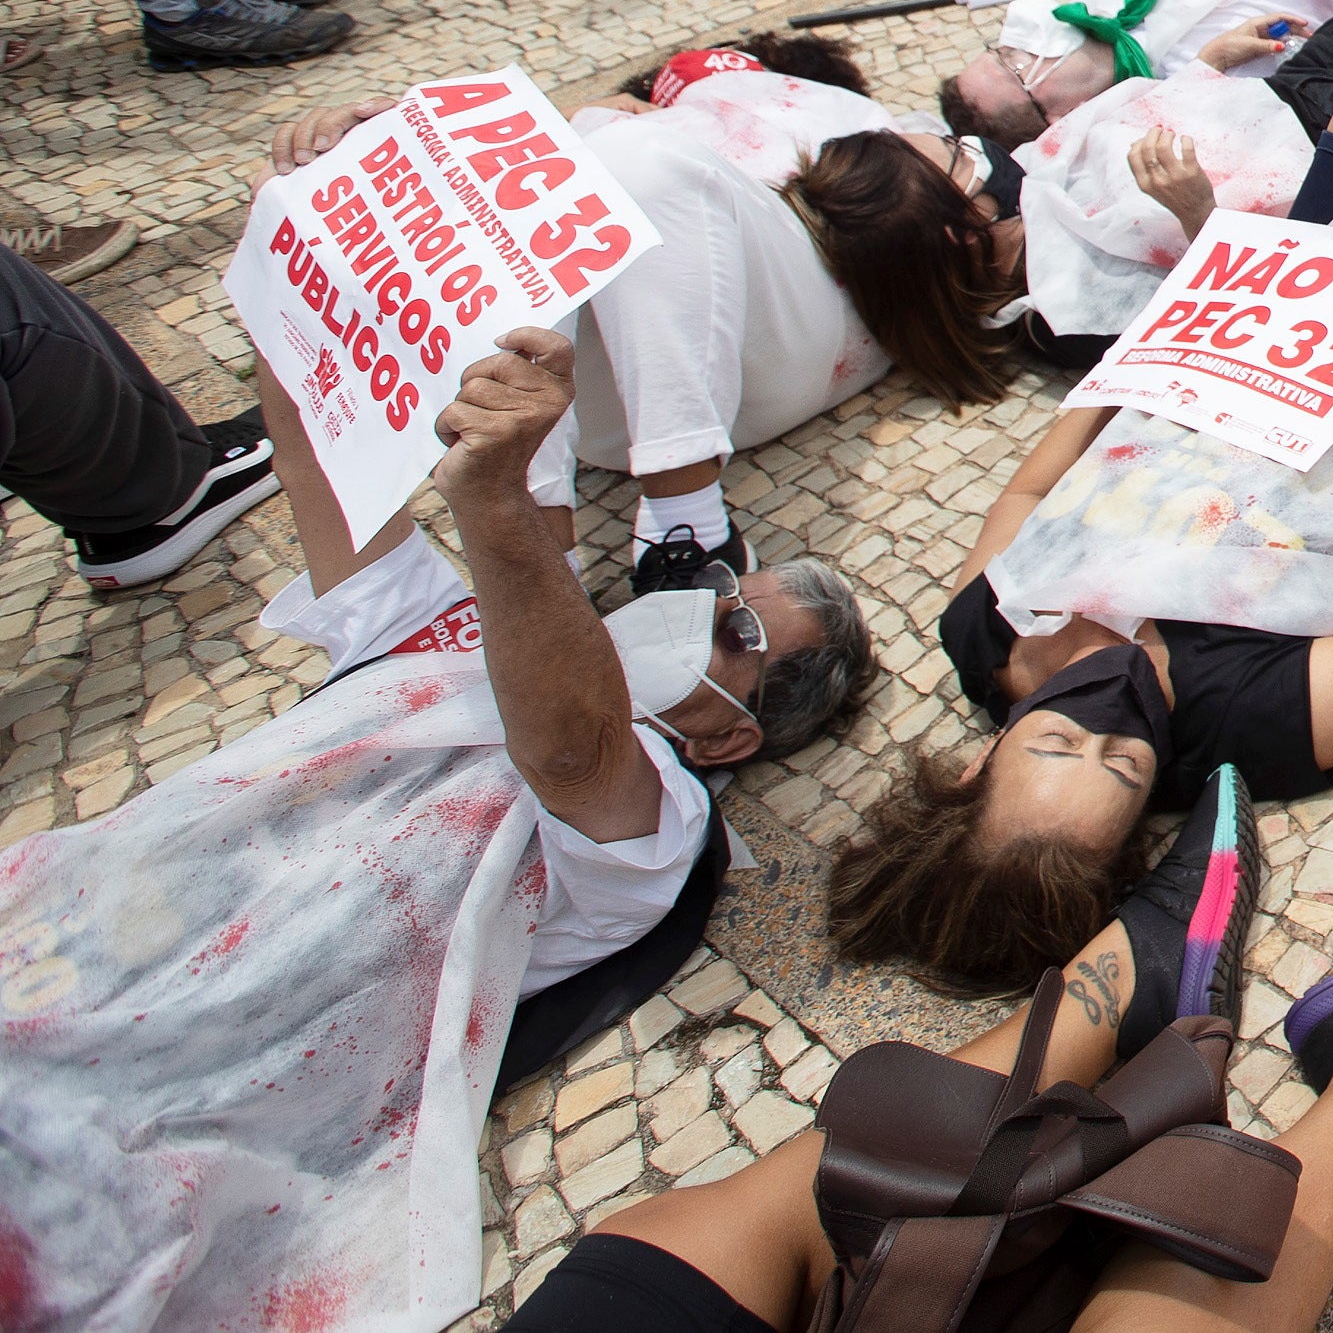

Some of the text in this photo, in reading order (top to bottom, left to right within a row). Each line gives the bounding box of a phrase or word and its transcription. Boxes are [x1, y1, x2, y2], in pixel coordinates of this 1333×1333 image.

[358, 136, 498, 327] DESTRÓI OS
[421, 82, 632, 298] A PEC 32
[443, 164, 556, 309] ADMINISTRATIVA)
[269, 215, 420, 432] PÚBLICOS
[311, 175, 452, 375] SERVIÇOS
[1138, 300, 1271, 350] PEC
[1126, 349, 1182, 366] REFORMA
[1179, 351, 1322, 415] ADMINISTRATIVA
[1266, 427, 1310, 452] CUT
[430, 619, 459, 652] BOLS
[446, 603, 484, 649] FO
